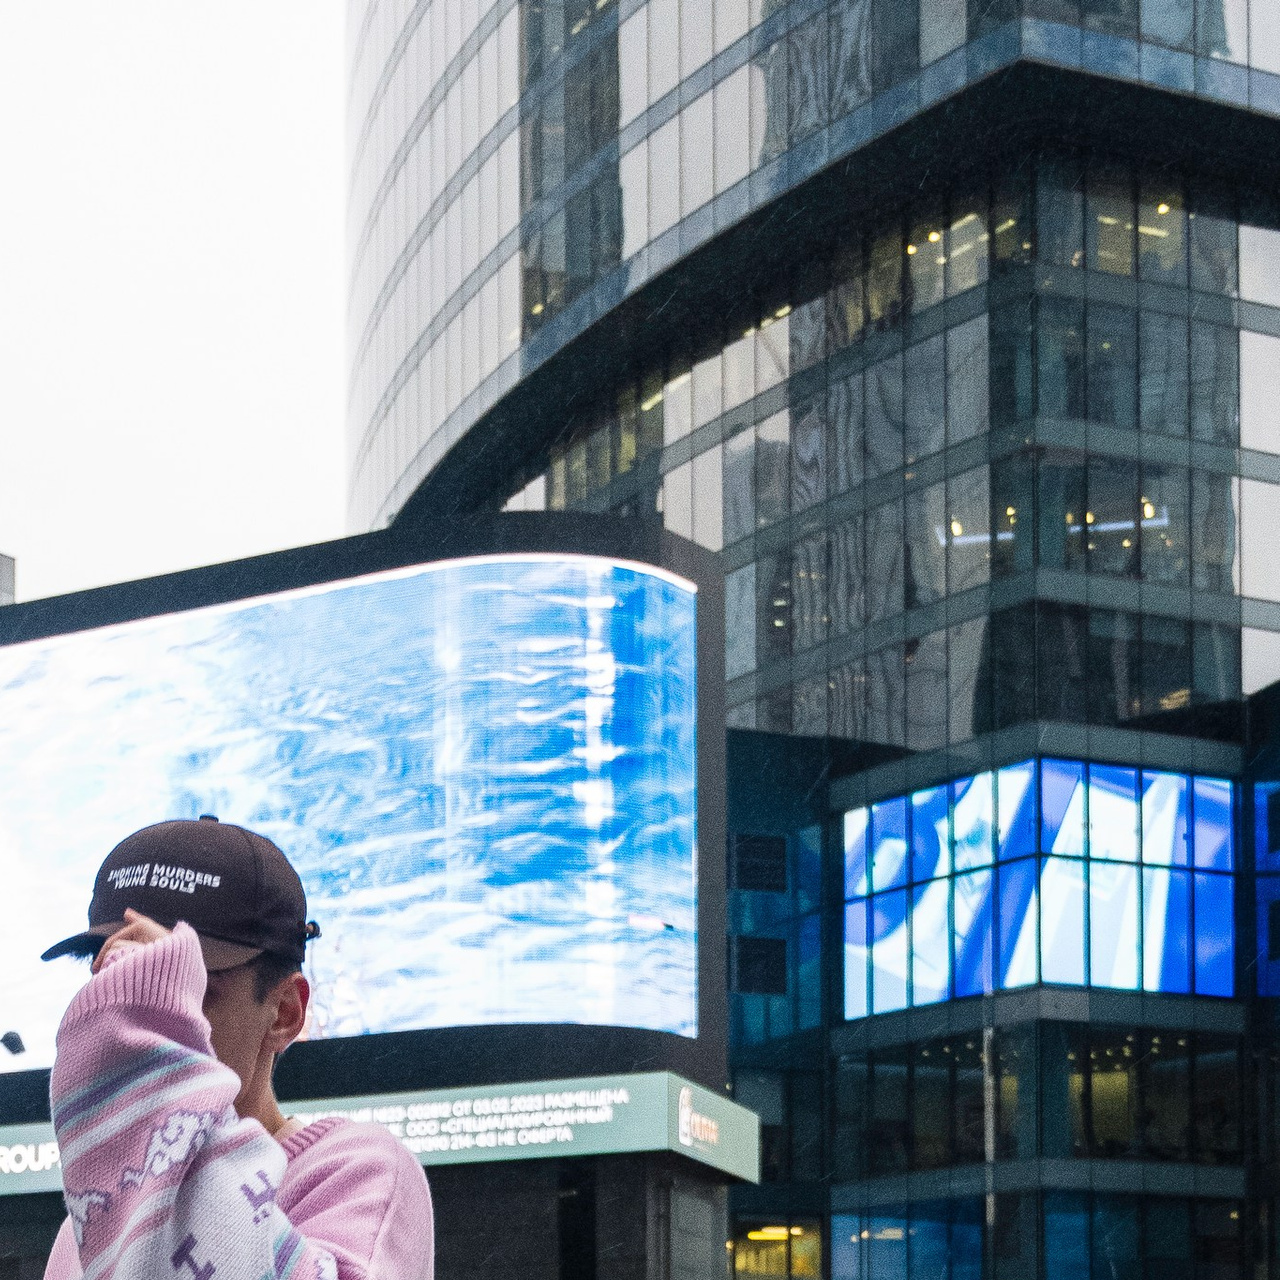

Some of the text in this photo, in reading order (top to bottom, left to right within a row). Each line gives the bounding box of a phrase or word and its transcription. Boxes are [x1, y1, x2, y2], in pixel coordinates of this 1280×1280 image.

[107, 863, 221, 888] SMOKING MURDERS
[114, 873, 196, 894] YOUNG SOULS
[406, 1119, 440, 1138] ООО
[518, 1126, 573, 1146] ОФЕРТА
